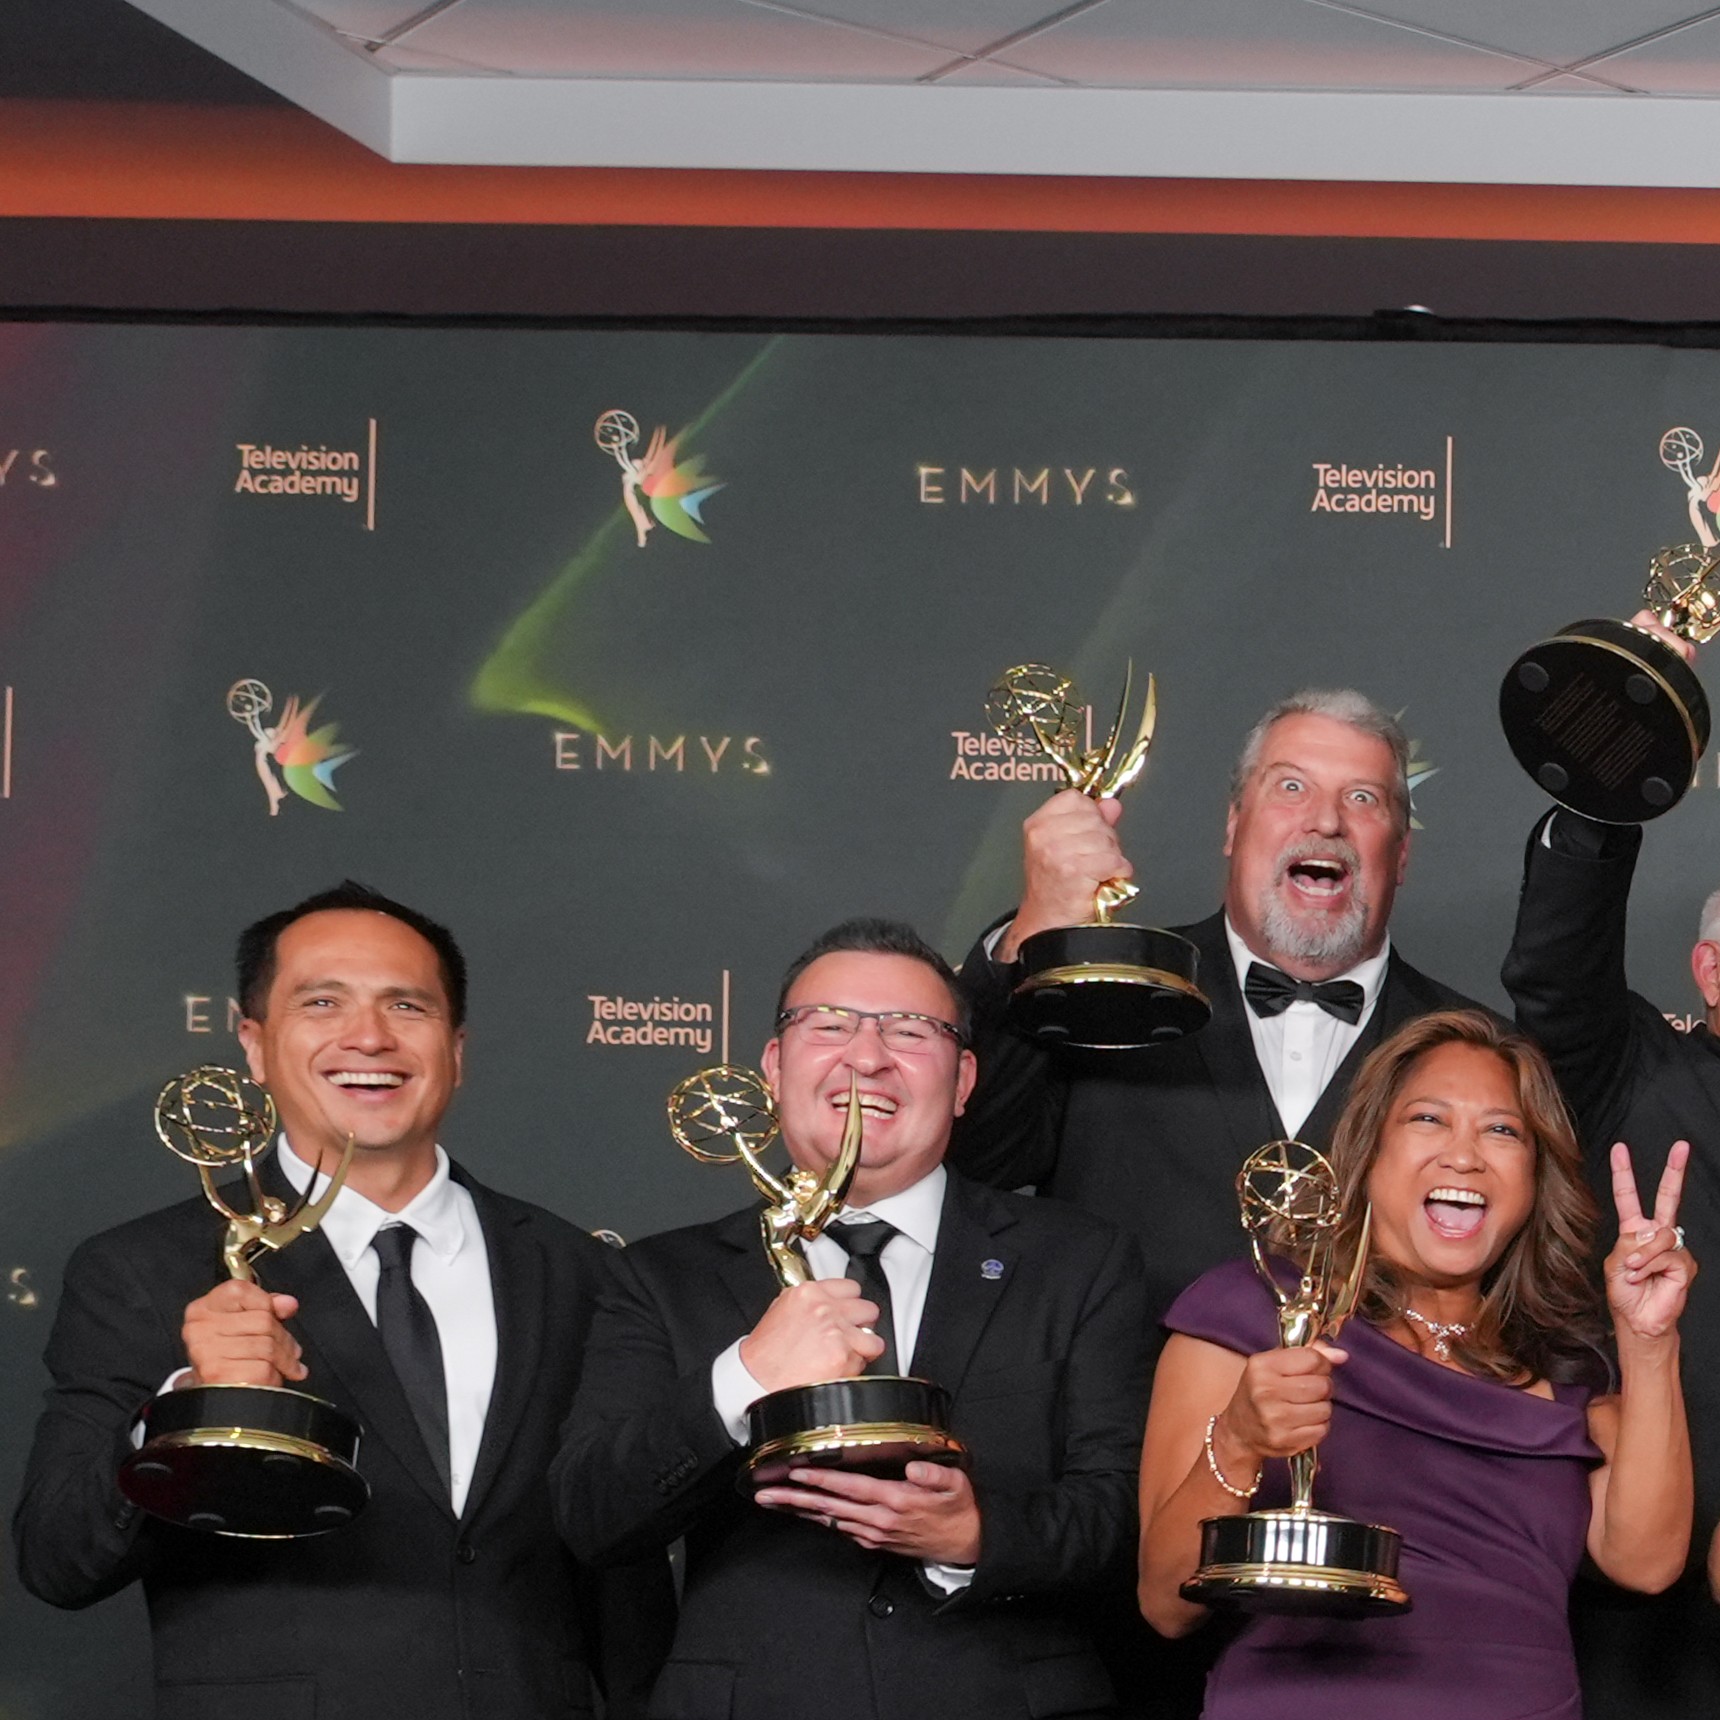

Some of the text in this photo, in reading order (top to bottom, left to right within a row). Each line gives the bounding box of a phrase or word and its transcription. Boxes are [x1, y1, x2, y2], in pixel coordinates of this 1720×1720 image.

[236, 444, 359, 470] Television
[235, 470, 358, 502] Academy
[918, 466, 1137, 507] EMMYS
[1312, 464, 1435, 488] Television
[1312, 488, 1434, 520] Academy
[555, 732, 771, 776] EMMYS
[588, 996, 712, 1021] Television
[587, 1021, 712, 1053] Academy
